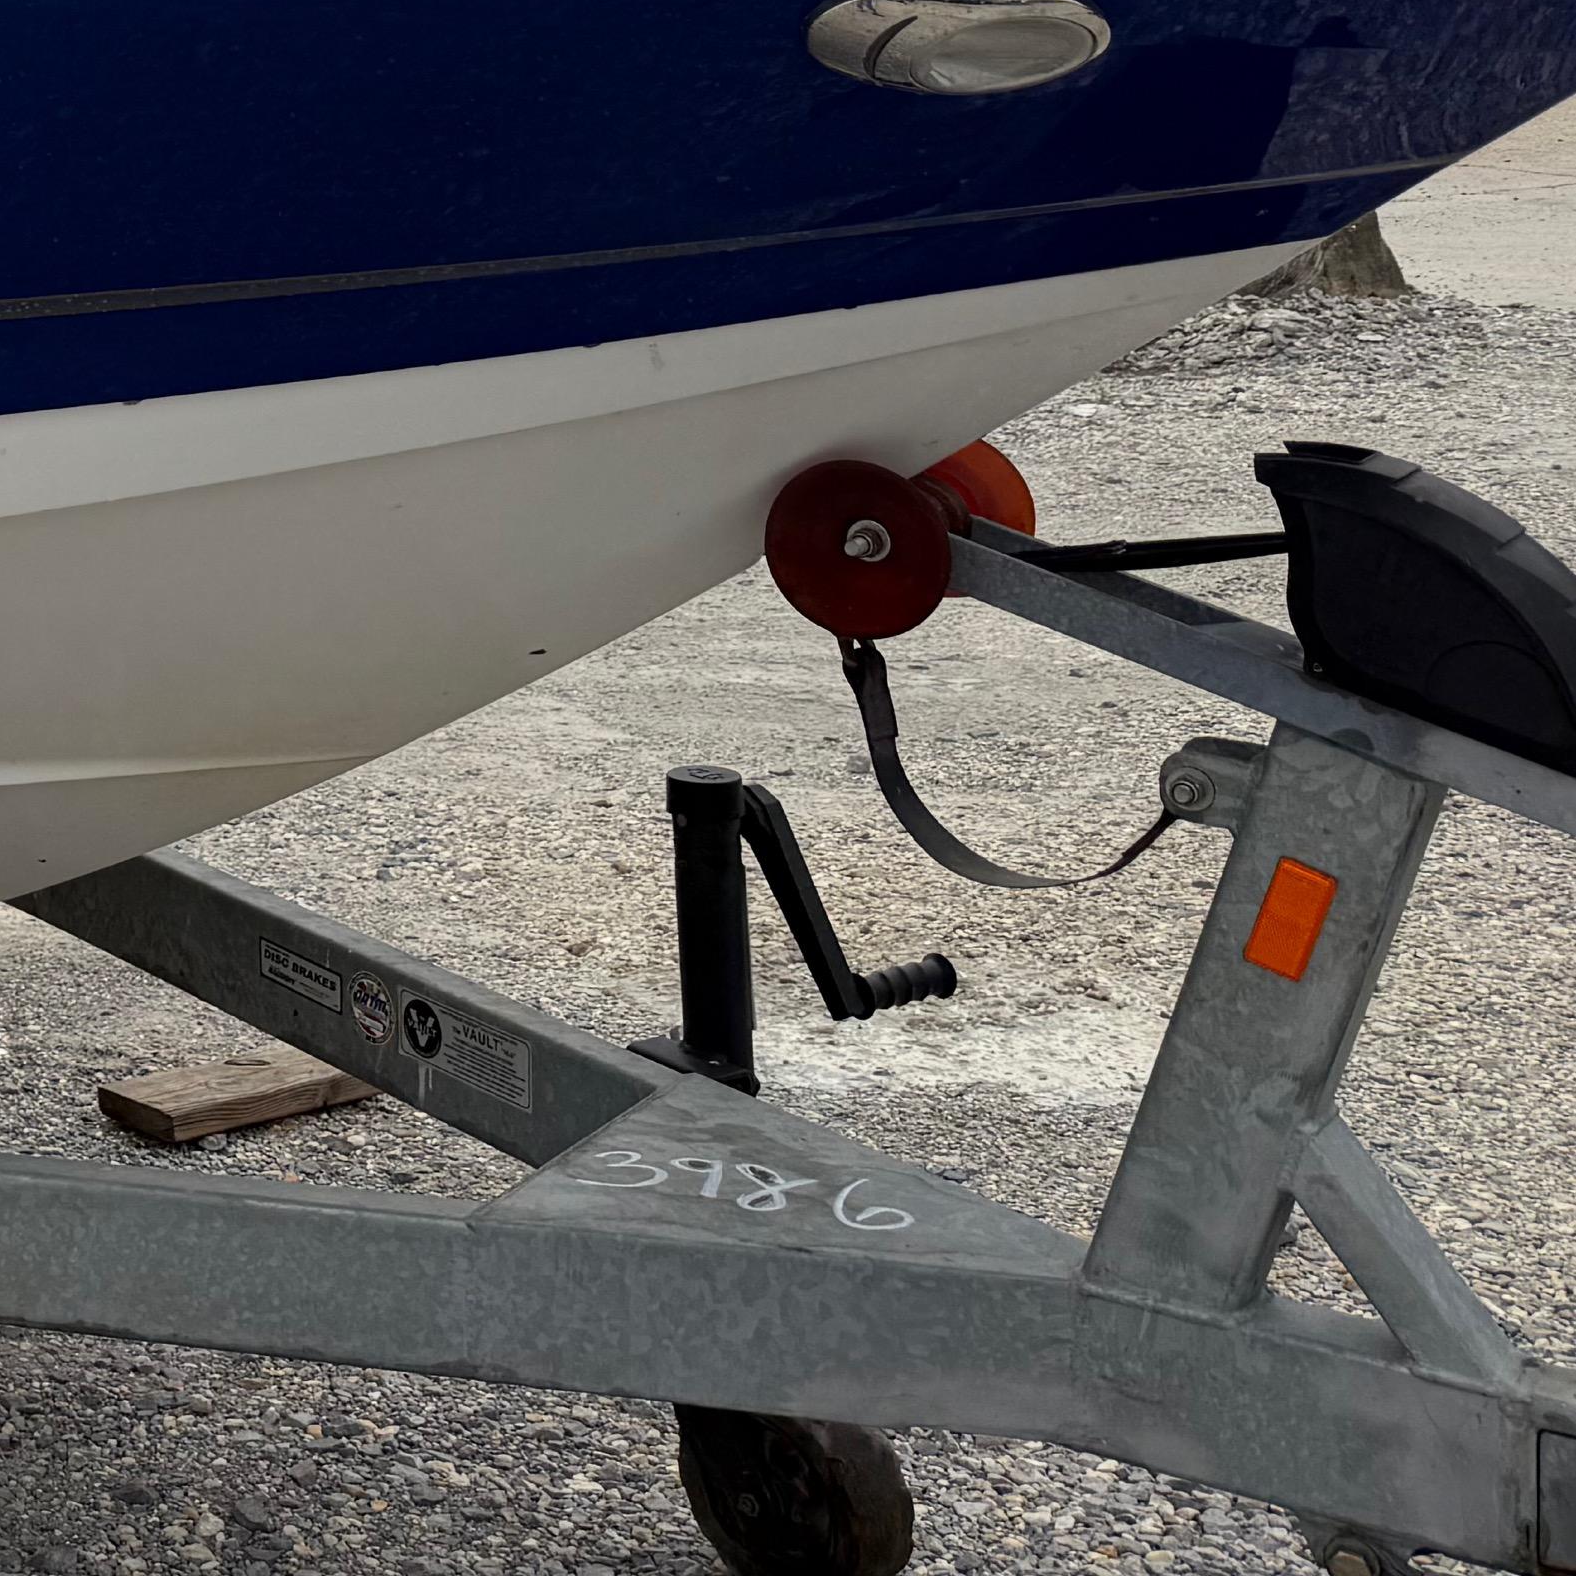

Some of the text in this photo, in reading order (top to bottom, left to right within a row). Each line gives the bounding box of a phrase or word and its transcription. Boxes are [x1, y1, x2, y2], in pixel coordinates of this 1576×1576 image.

[264, 948, 289, 968] DISC
[292, 962, 336, 992] BRAKES
[462, 1025, 499, 1051] VAULT
[576, 1151, 916, 1231] 3986
